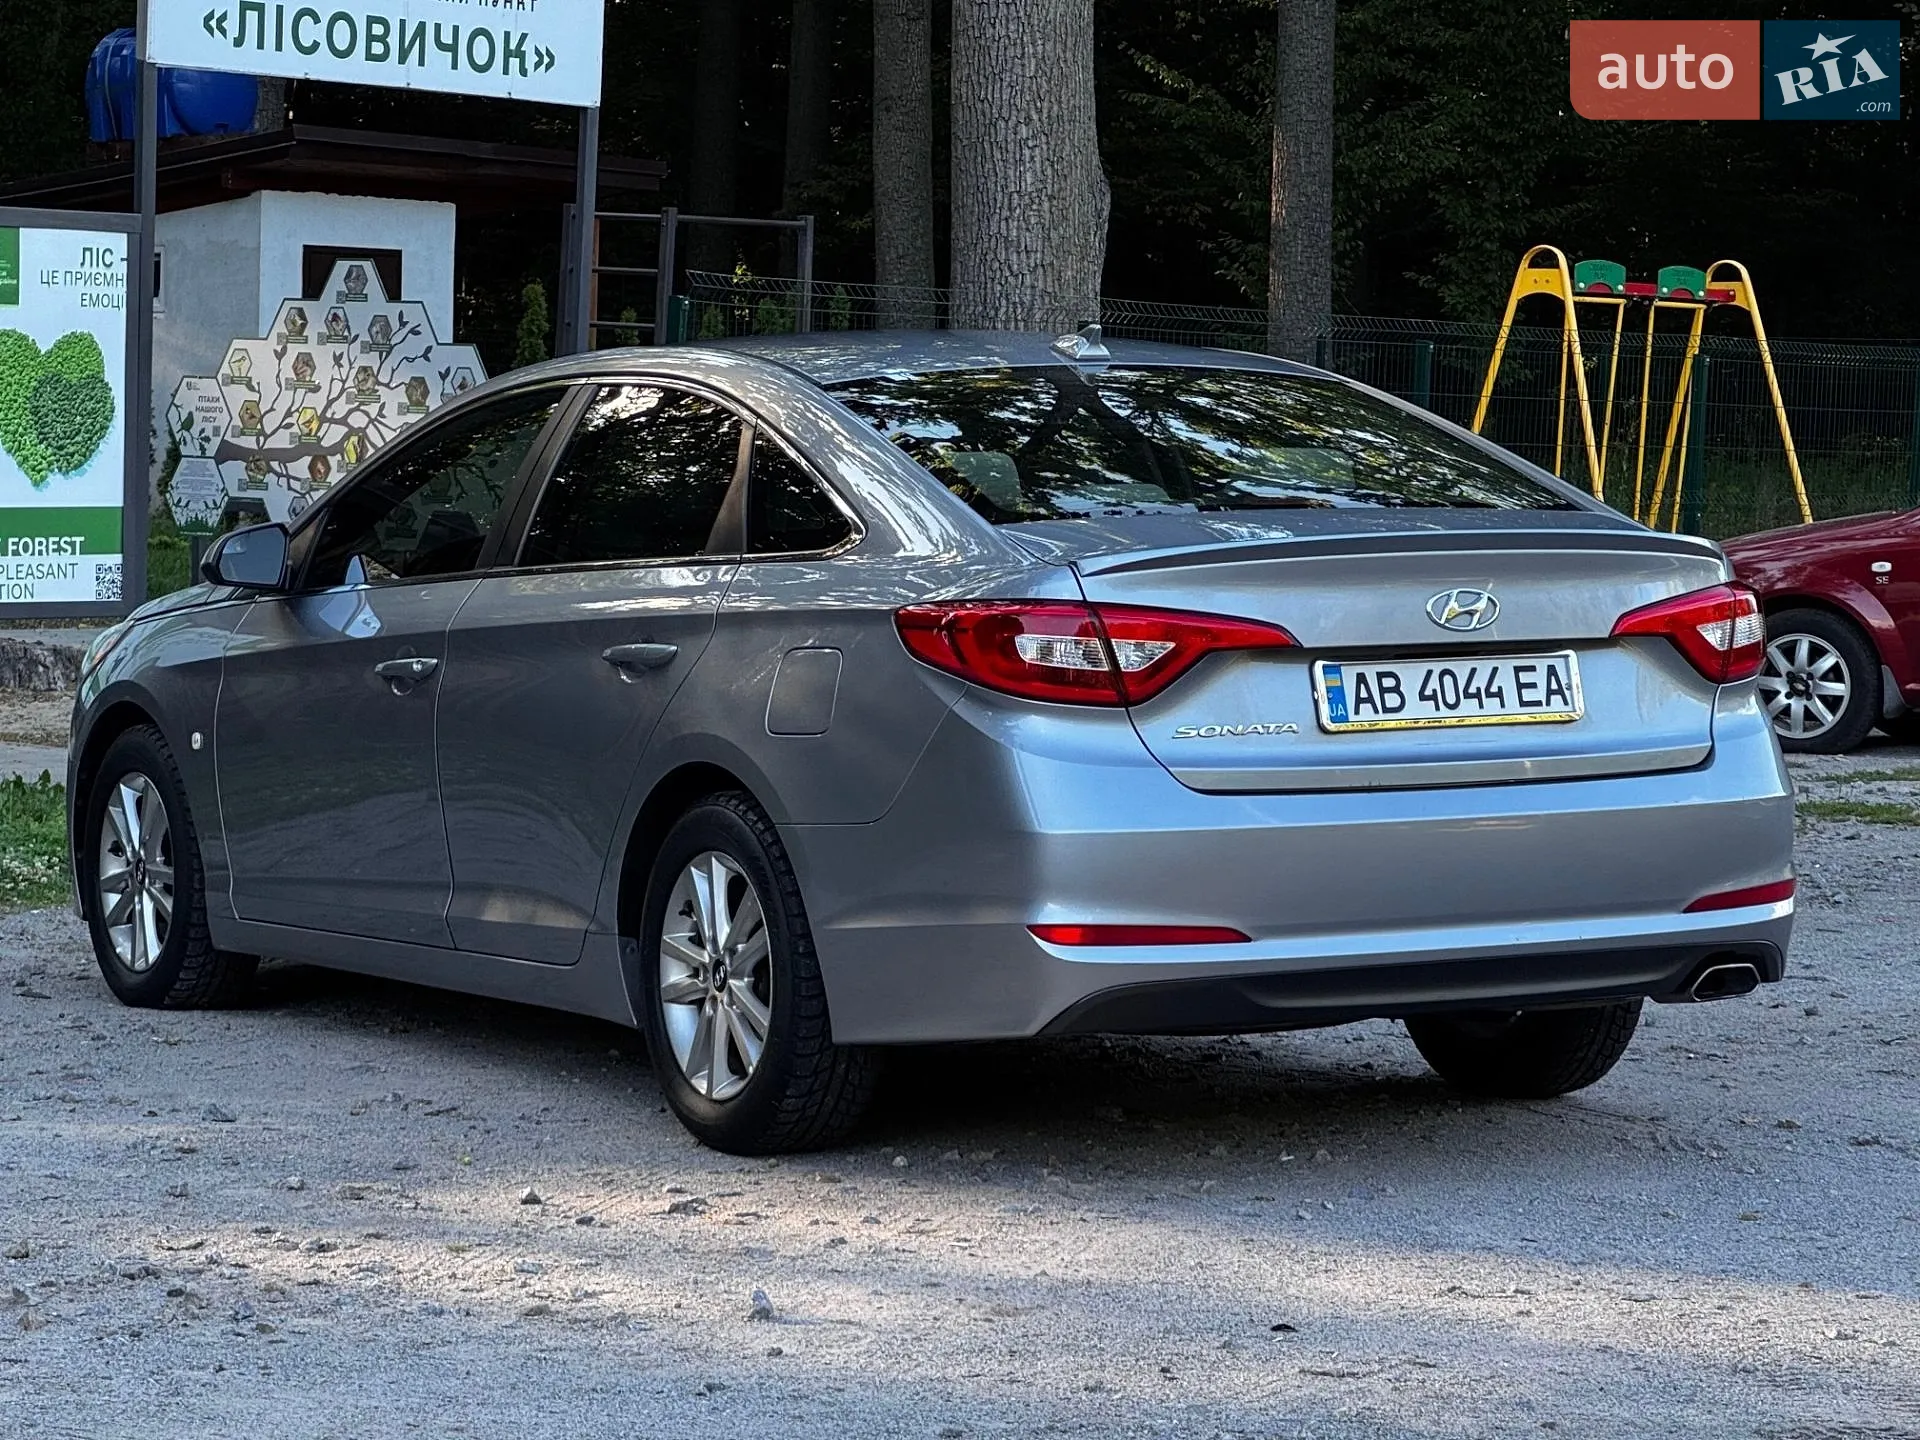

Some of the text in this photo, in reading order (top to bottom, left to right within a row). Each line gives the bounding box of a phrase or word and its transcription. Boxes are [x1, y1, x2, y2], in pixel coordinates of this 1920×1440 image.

[80, 247, 114, 268] ЛІС
[40, 270, 60, 288] ЦЕ
[7, 536, 85, 556] FOREST
[1875, 575, 1889, 585] SE
[1353, 664, 1569, 716] AB 4044 EA
[1329, 703, 1346, 717] UA
[1171, 722, 1299, 739] SONATA
